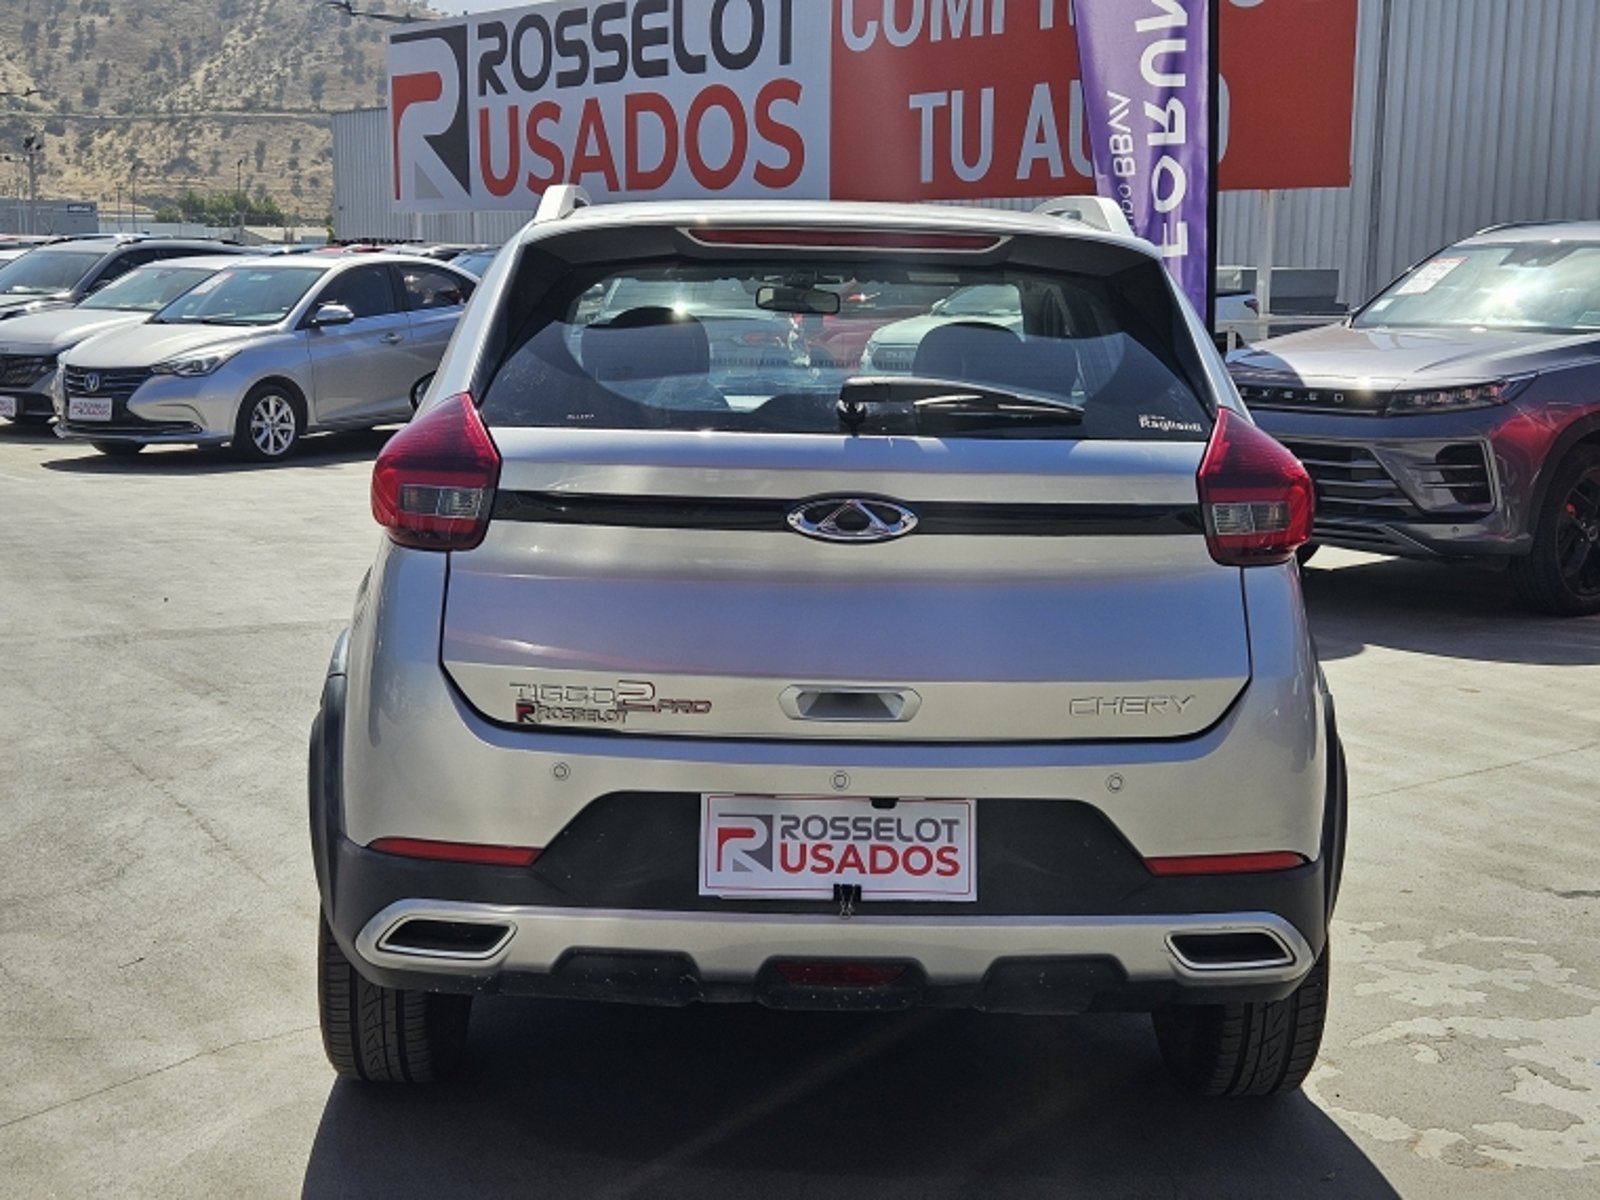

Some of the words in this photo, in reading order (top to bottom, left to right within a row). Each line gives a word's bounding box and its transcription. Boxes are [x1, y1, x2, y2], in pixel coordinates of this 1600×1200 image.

[478, 77, 806, 197] USADOS
[908, 85, 995, 184] TU
[537, 703, 628, 724] ROSSELOT
[656, 698, 713, 714] PRO
[1068, 693, 1197, 717] CHERY
[779, 814, 960, 844] ROSSELOT
[779, 842, 961, 878] USADOS
